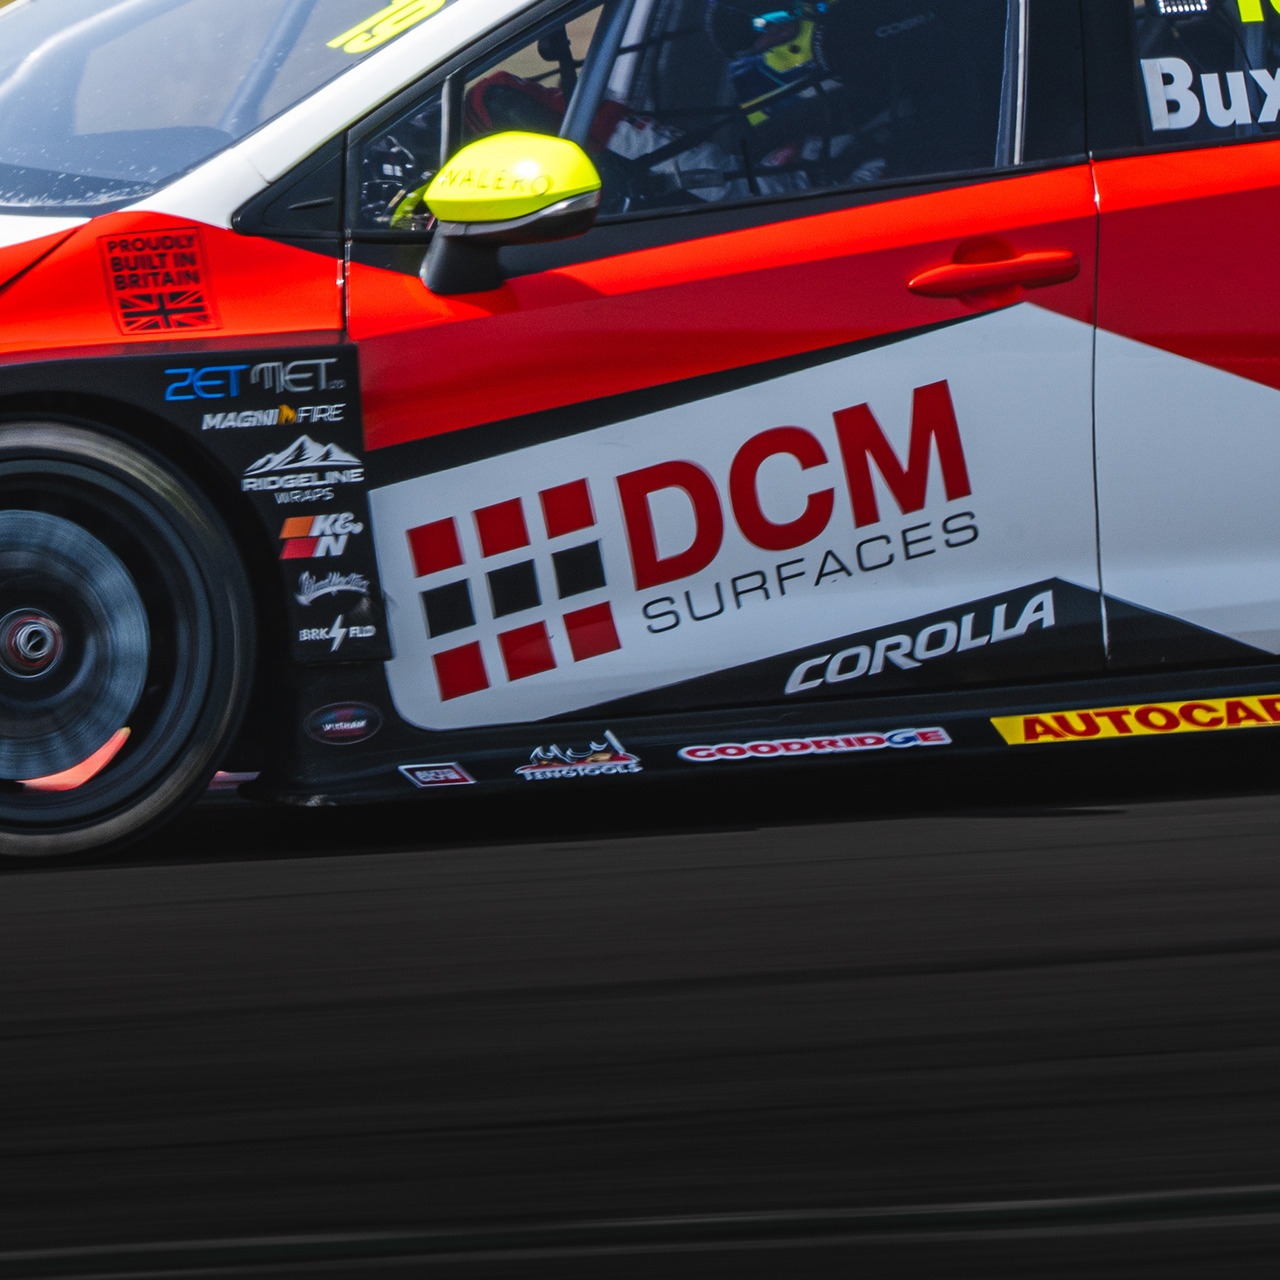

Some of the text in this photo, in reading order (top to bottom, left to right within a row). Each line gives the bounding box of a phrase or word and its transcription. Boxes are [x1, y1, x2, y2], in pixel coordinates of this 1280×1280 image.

[107, 233, 195, 253] PROUDLY
[110, 251, 197, 273] BUILT IN
[114, 270, 200, 290] BRITAIN
[241, 469, 365, 491] RIDGELINE
[615, 379, 973, 592] DCM
[275, 488, 335, 504] WRAPS
[641, 510, 980, 634] SURFACES
[784, 589, 1056, 695] COROLLA
[684, 727, 948, 760] GOODRIDGE
